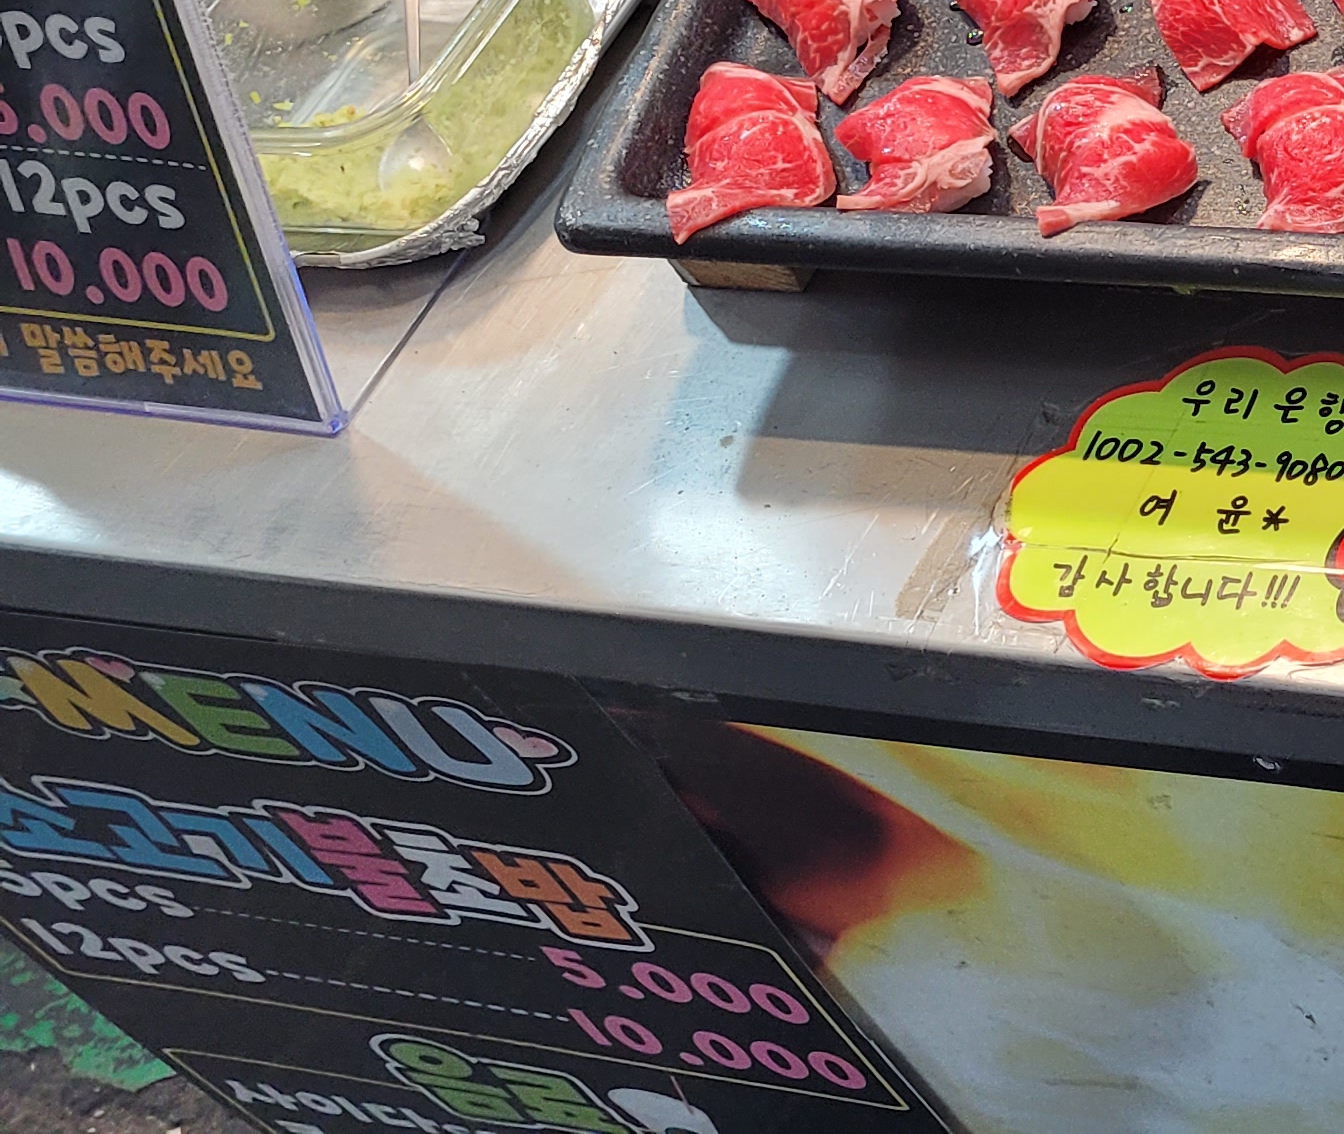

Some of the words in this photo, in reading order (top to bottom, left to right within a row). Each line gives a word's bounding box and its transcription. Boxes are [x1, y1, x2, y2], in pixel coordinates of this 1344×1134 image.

[0, 9, 126, 70] pcs
[0, 158, 186, 233] 12pcs
[7, 238, 228, 312] 10.000
[20, 322, 263, 391] 말씀해주세요
[1053, 556, 1300, 610] 감사합니다!!!
[8, 655, 537, 787] MENU
[20, 918, 267, 983] 12pcs
[567, 1008, 868, 1090] 10.000
[539, 945, 811, 1025] 5.000
